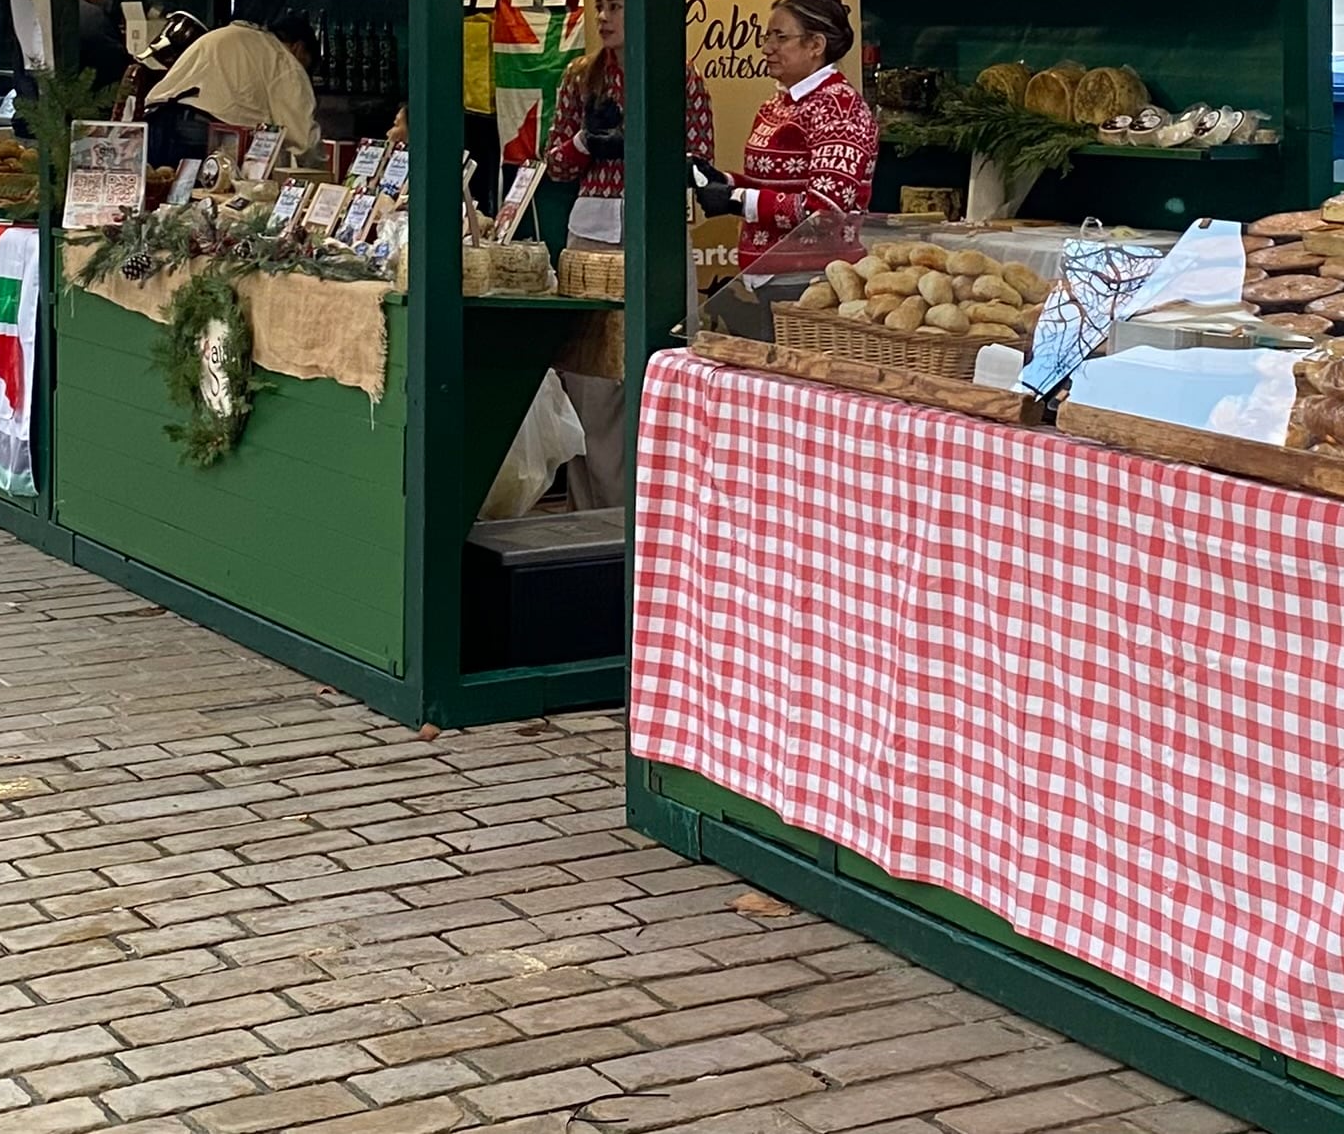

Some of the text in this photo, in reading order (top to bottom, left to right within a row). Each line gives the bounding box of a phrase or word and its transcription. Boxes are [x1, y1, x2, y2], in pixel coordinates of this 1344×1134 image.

[704, 52, 770, 79] artesa
[811, 144, 864, 164] MERRY
[808, 157, 858, 175] XMAS
[692, 244, 739, 266] arte
